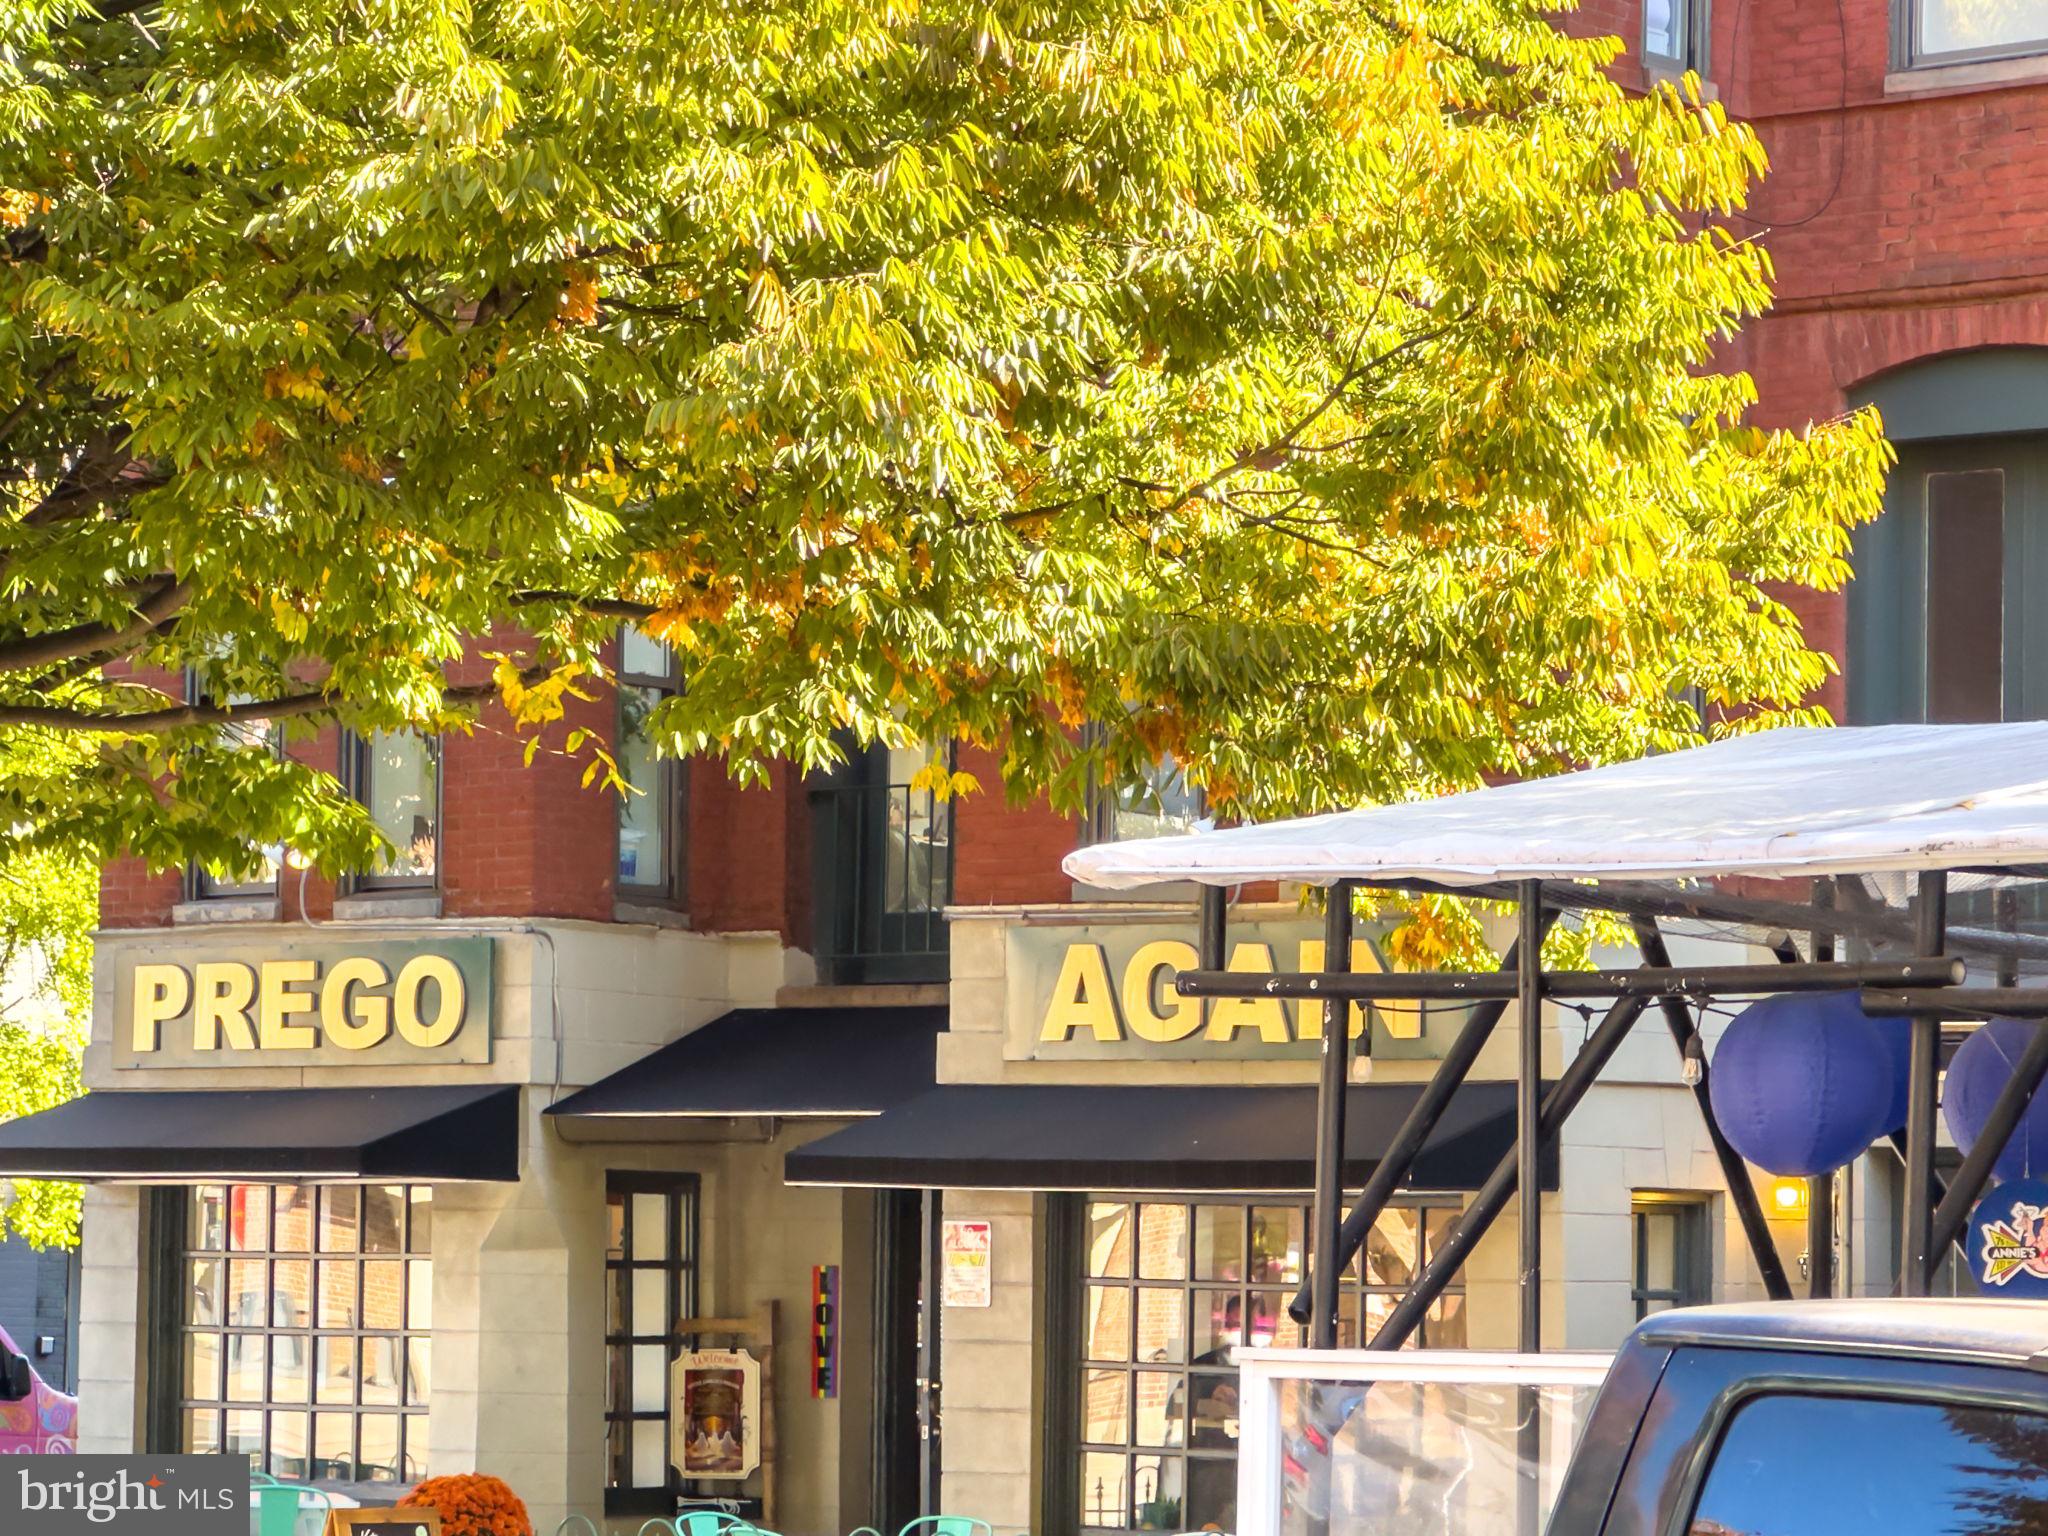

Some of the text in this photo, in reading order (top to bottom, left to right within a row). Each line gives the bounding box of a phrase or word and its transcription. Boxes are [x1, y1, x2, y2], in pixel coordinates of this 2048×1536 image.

[133, 954, 466, 1052] PREGO
[1040, 940, 1424, 1043] AGAIN
[1992, 1246, 2037, 1259] ANNIE'S
[815, 1271, 834, 1390] LOVE
